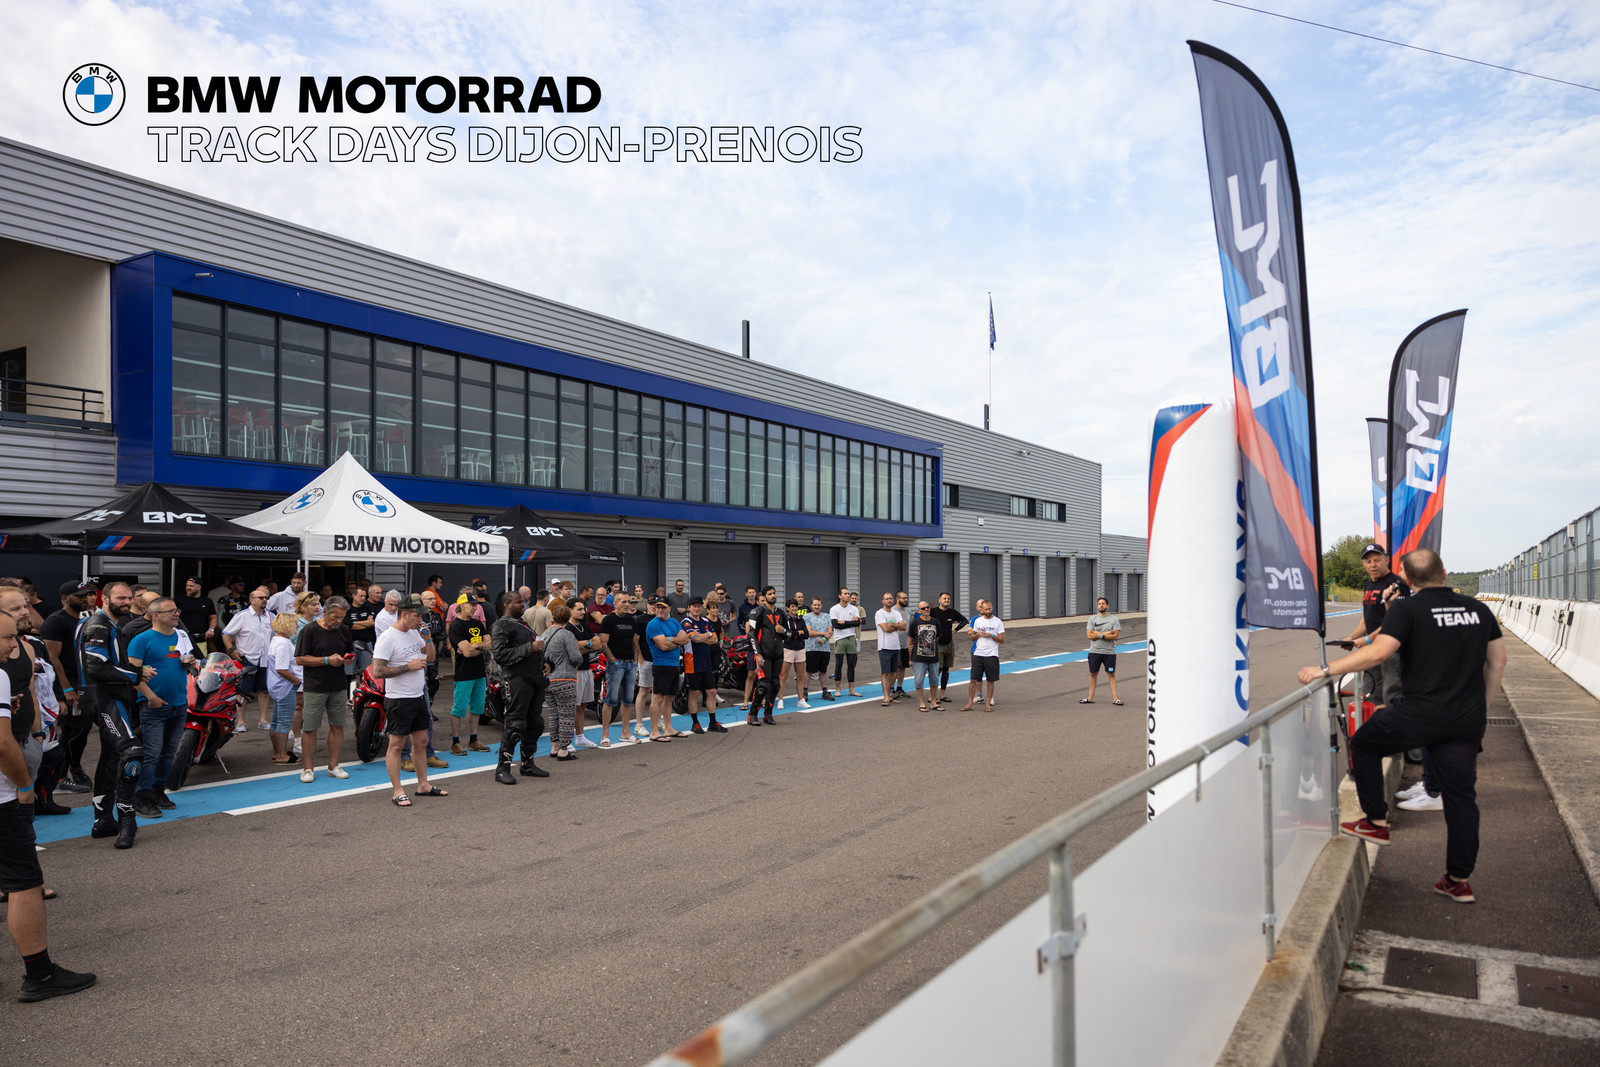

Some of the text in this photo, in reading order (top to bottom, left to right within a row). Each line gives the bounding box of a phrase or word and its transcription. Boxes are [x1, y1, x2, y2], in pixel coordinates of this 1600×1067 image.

[1405, 369, 1450, 493] BMC
[143, 511, 207, 525] BMC
[526, 526, 564, 537] BMC
[236, 543, 289, 552] bmc-moto.com
[334, 534, 490, 556] BMW MOTORRAD
[1433, 611, 1480, 627] TEAM
[1148, 638, 1157, 796] OTORRAD
